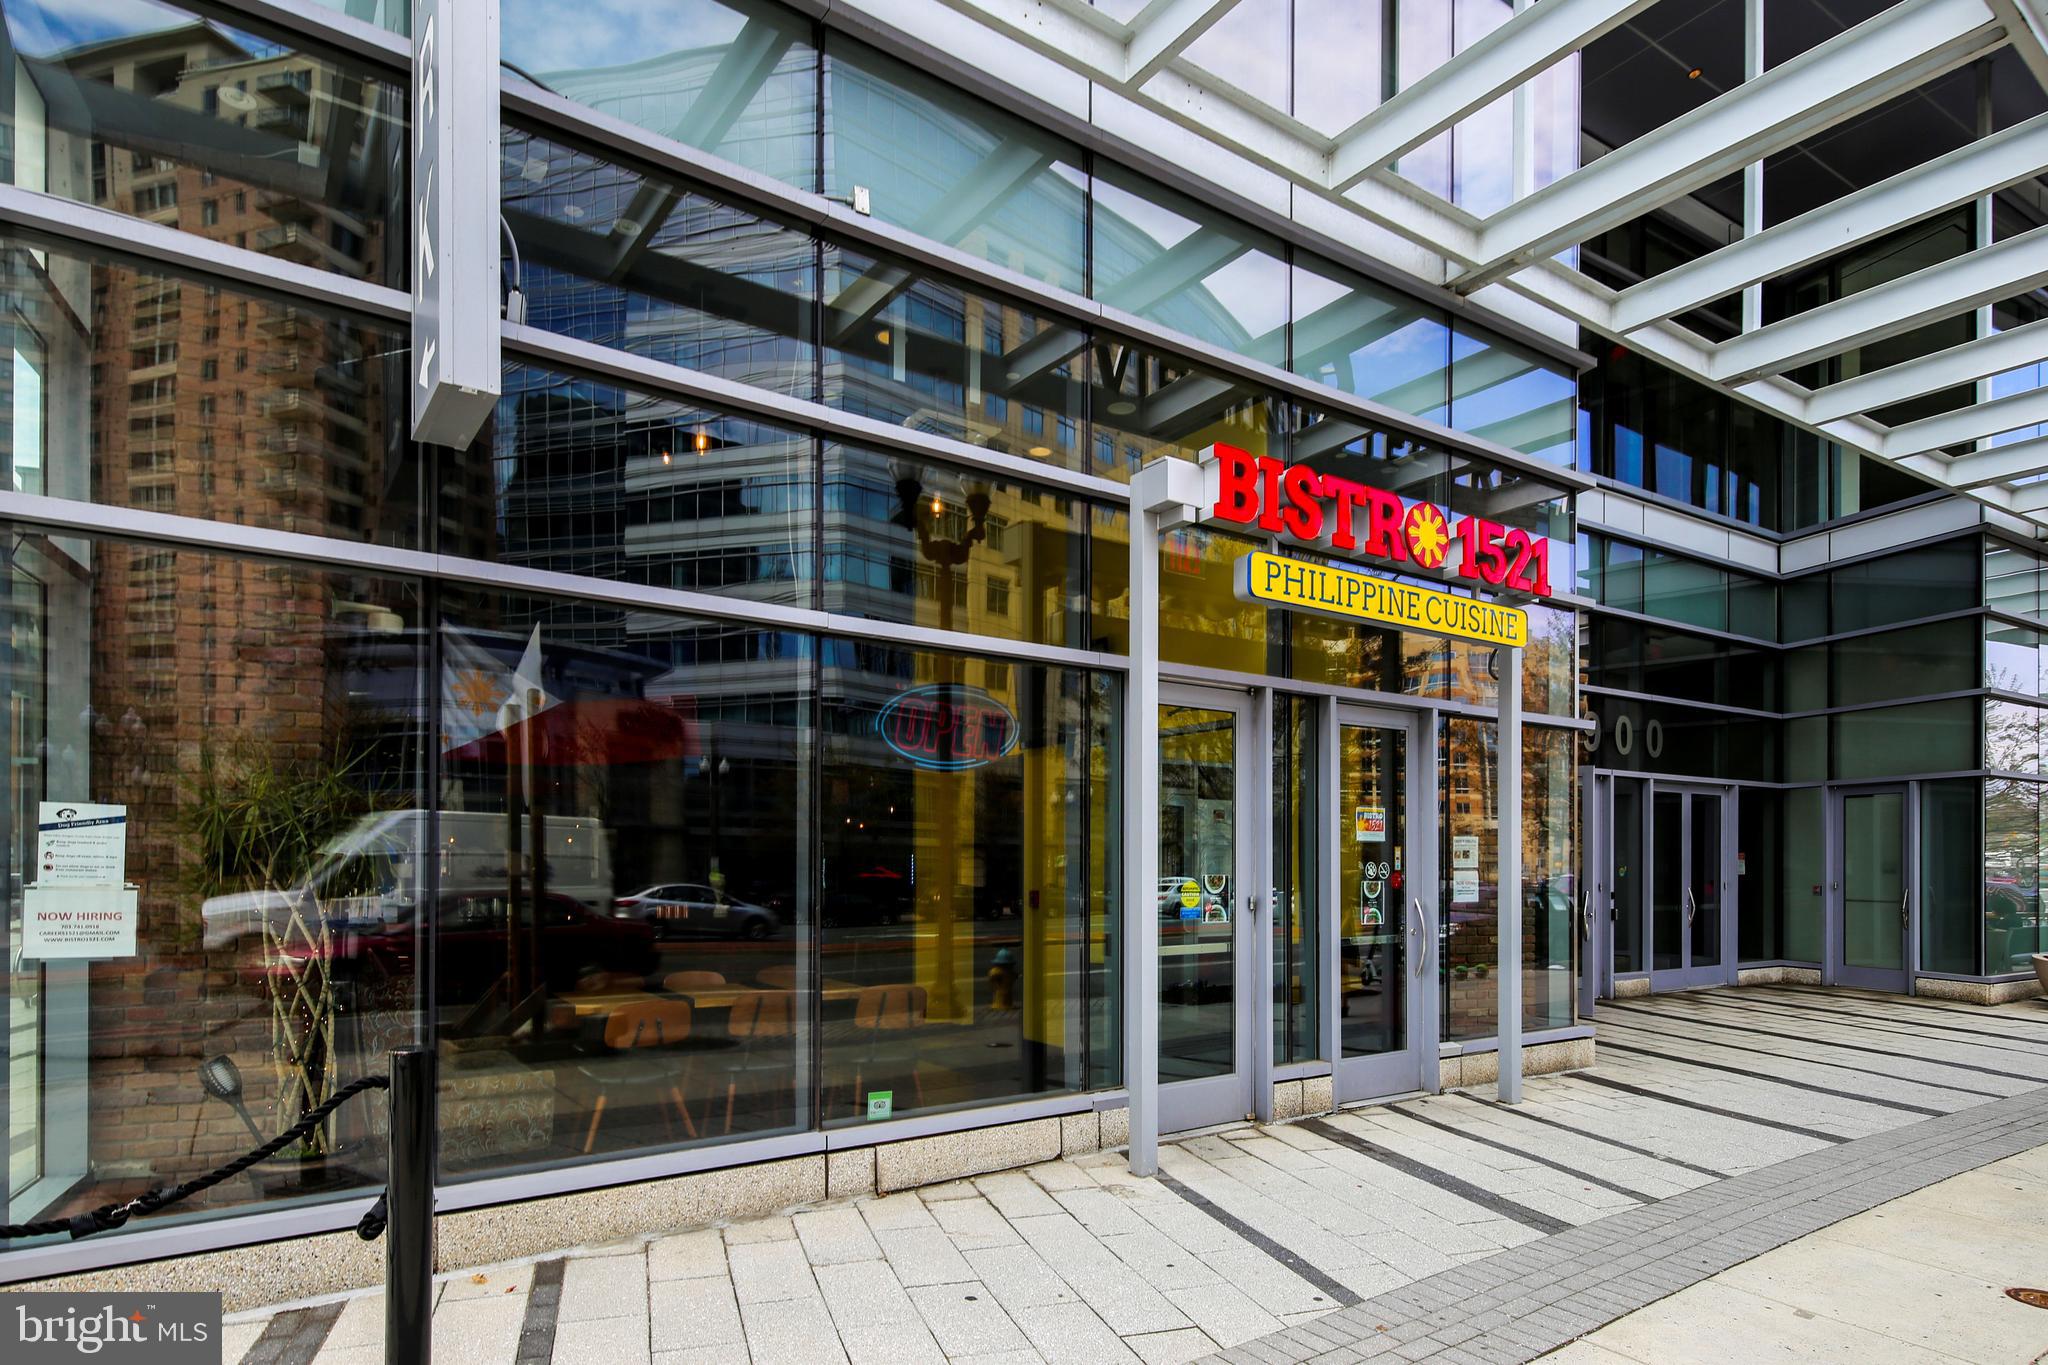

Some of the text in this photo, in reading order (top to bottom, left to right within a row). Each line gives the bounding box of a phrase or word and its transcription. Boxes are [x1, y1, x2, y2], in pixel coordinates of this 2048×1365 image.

[1213, 441, 1552, 597] BISTRO 1521
[1264, 559, 1519, 641] PHILIPPINE CUISINE
[895, 698, 1007, 761] OPEN
[37, 911, 123, 921] NOW HIRING
